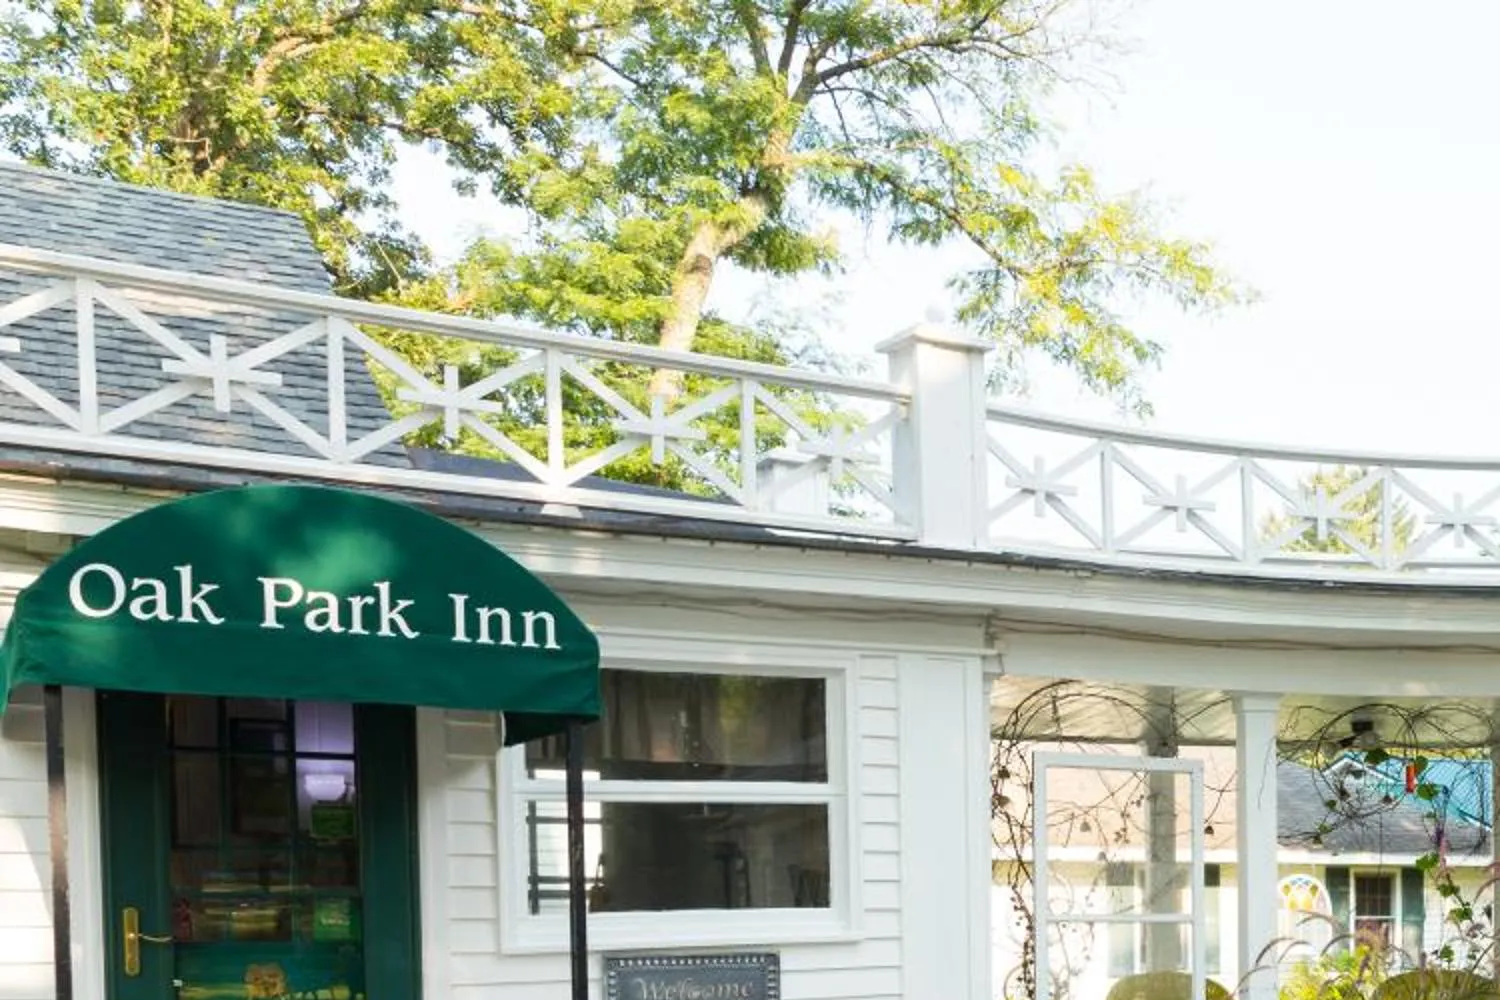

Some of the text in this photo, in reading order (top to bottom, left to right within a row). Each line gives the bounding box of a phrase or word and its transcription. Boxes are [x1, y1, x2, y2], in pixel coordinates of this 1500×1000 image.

[68, 563, 561, 649] Oak Park Inn
